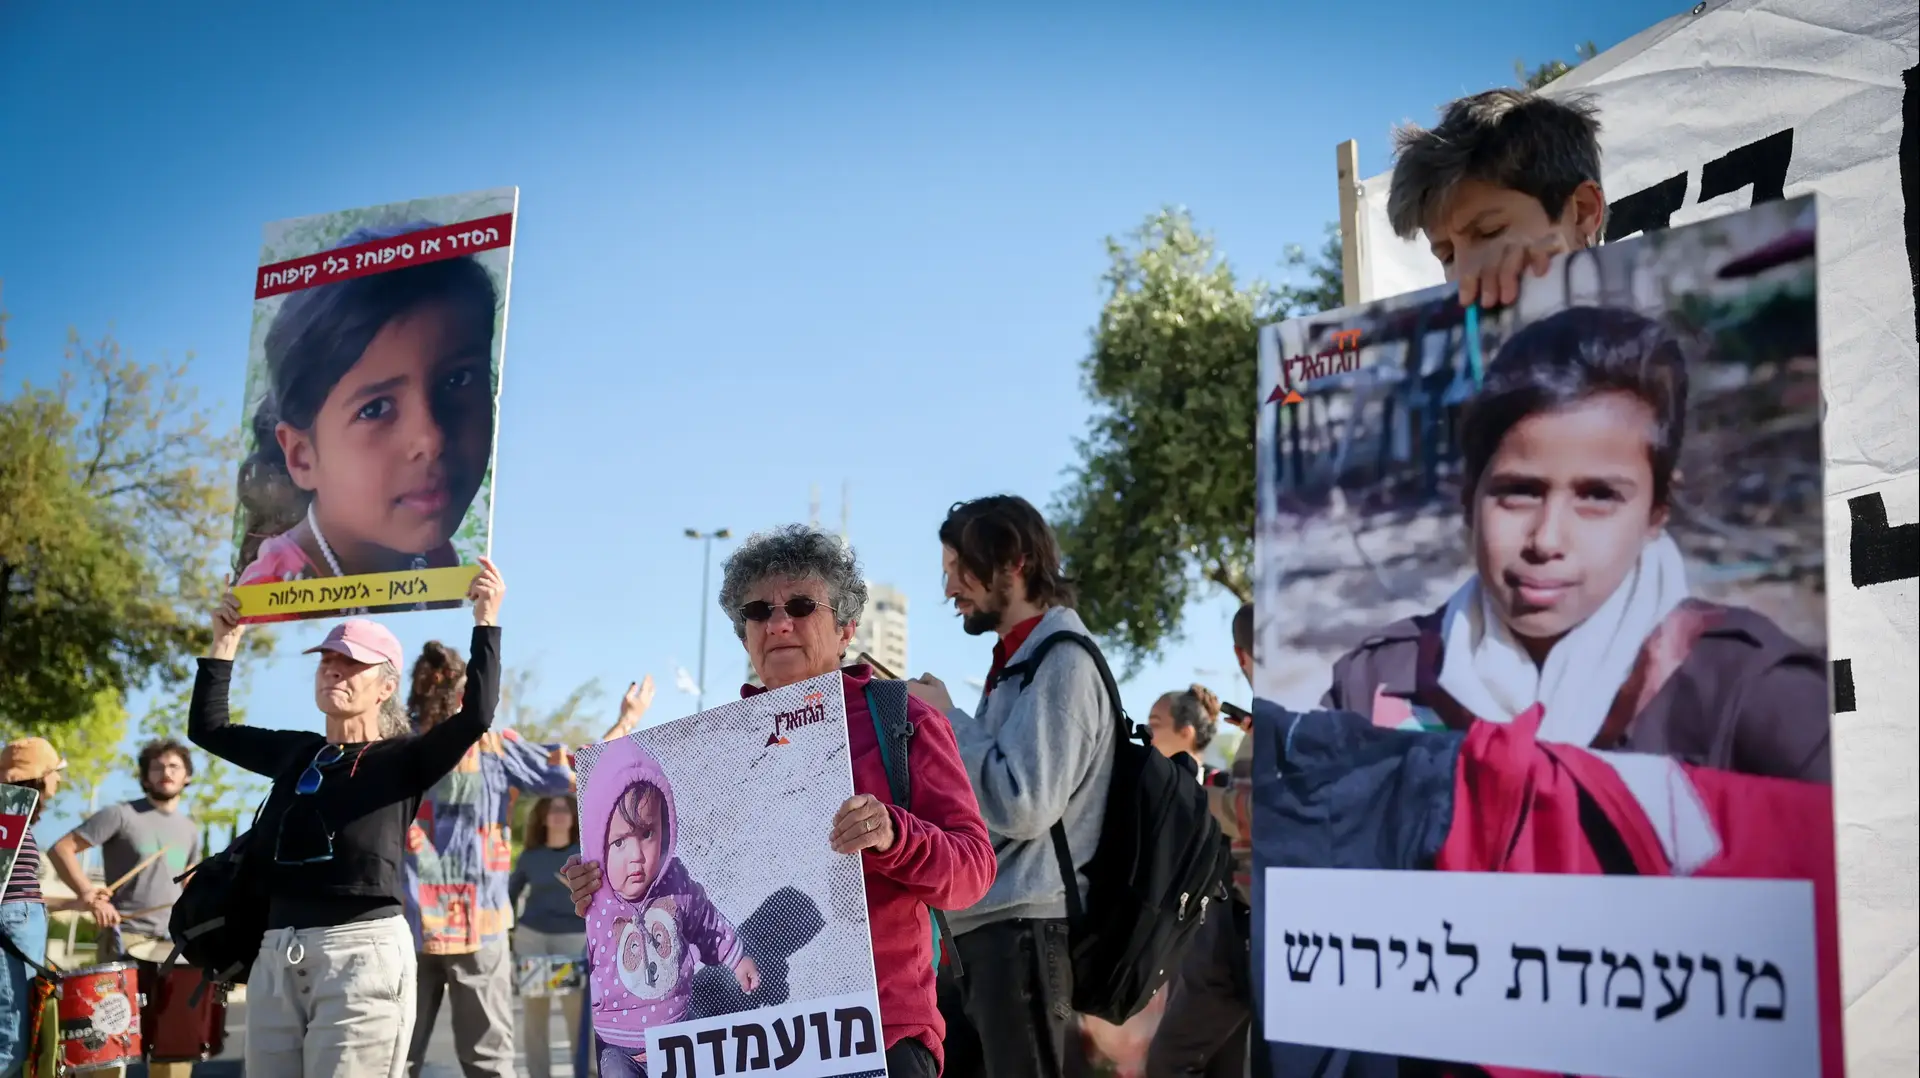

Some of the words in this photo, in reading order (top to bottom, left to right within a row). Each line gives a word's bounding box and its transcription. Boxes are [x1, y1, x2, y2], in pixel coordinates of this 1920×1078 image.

[420, 238, 441, 254] או
[447, 228, 499, 249] הסדר
[322, 257, 349, 274] בלי
[355, 243, 415, 270] סיפוח?
[262, 264, 317, 289] קיפוח!
[268, 587, 314, 607] חילווה
[319, 582, 370, 603] ג'מעת
[389, 577, 428, 600] ג'נאן
[1284, 919, 1479, 996] לגירוש
[1505, 942, 1787, 1022] מועמדת
[658, 1006, 878, 1078] מועמדת
